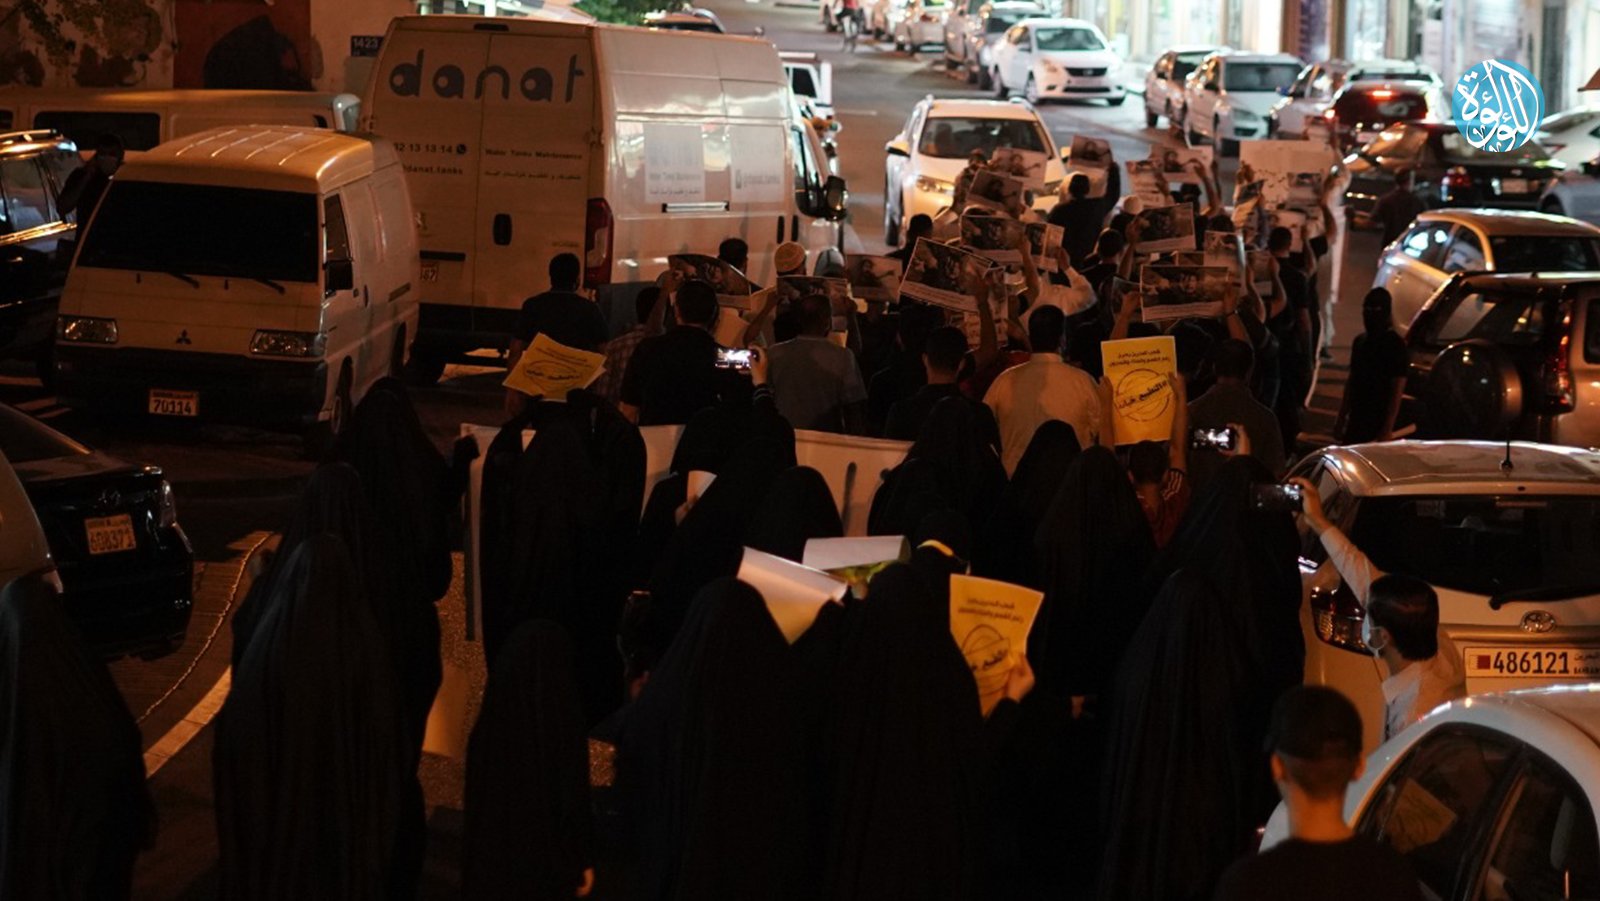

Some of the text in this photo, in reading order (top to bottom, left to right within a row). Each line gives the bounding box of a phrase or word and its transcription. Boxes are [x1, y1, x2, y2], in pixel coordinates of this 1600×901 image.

[353, 37, 379, 49] 1423
[389, 48, 584, 104] danat
[409, 143, 421, 153] 13
[425, 144, 437, 153] 13
[441, 144, 453, 154] 14
[153, 399, 192, 415] 70114
[1493, 650, 1570, 675] 486121
